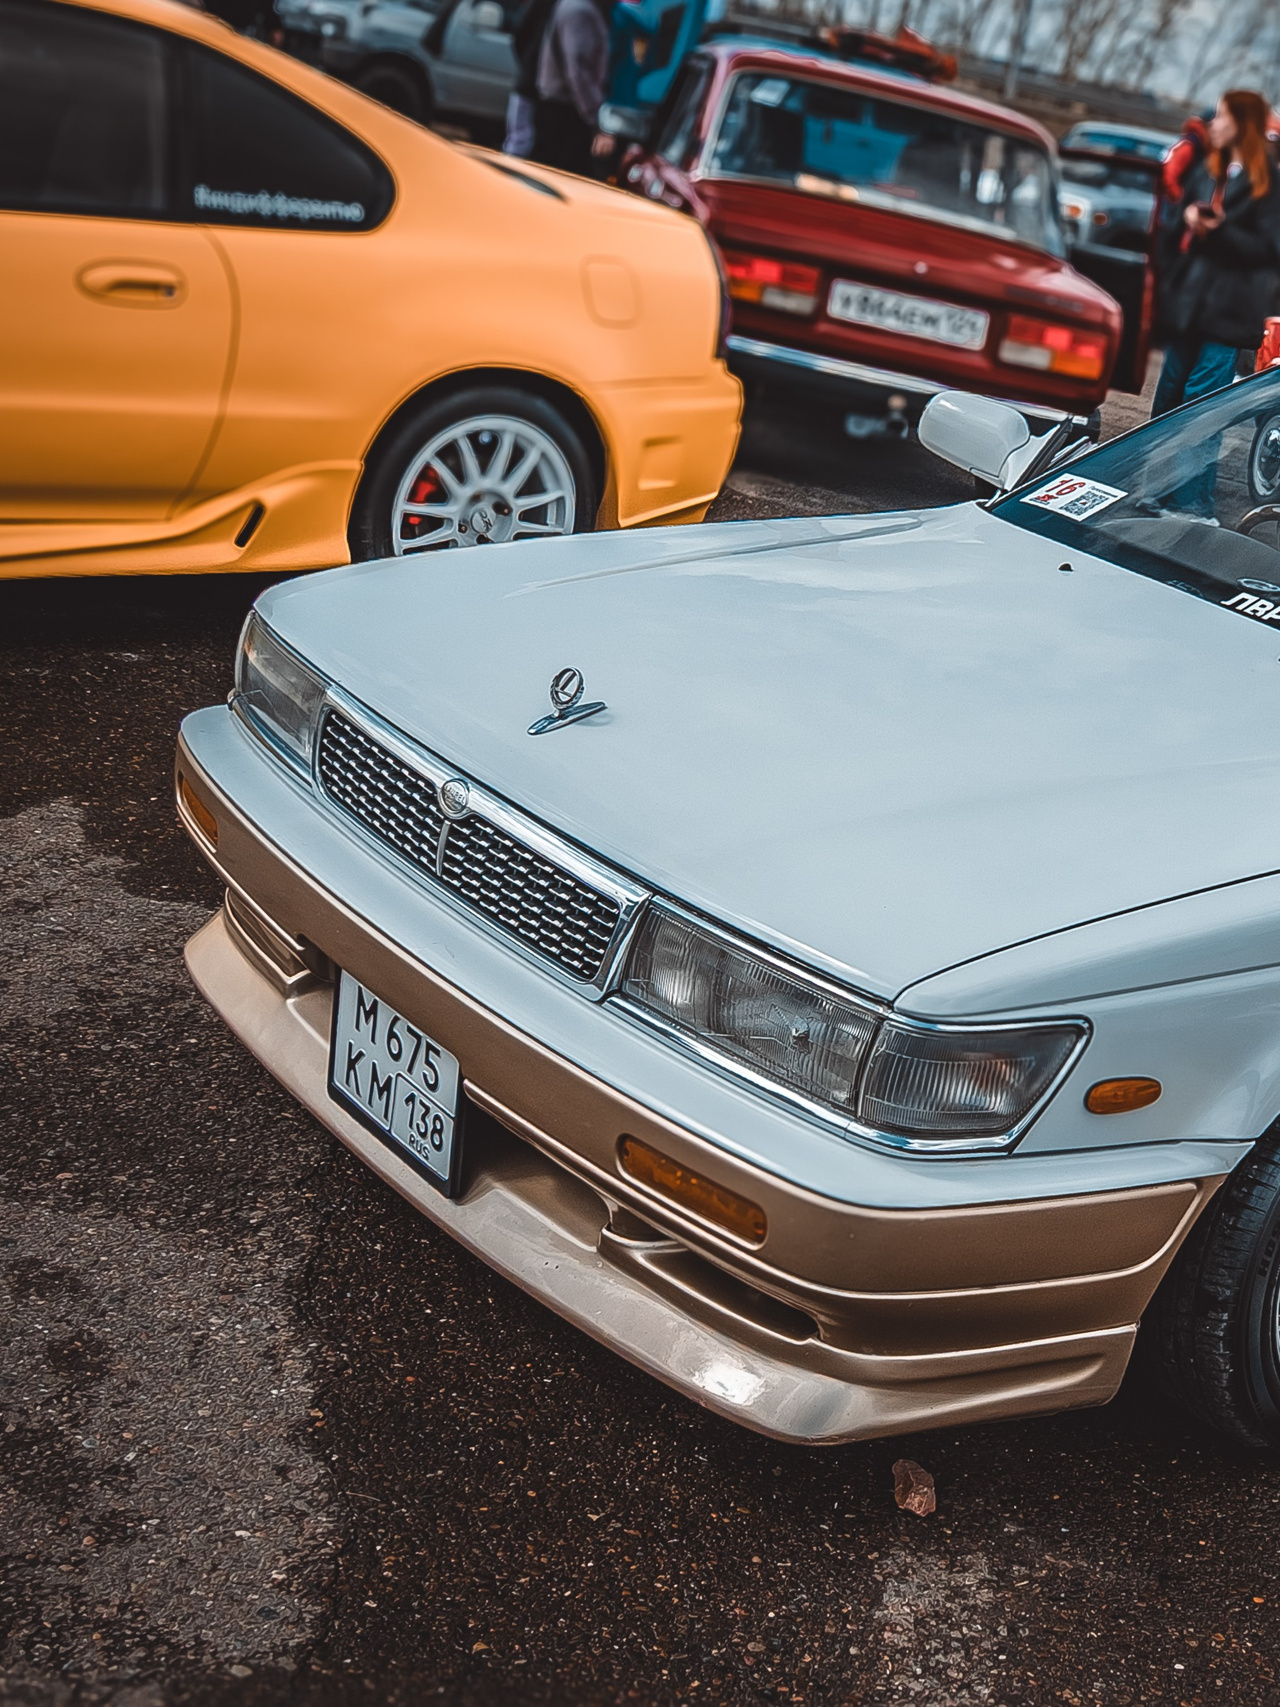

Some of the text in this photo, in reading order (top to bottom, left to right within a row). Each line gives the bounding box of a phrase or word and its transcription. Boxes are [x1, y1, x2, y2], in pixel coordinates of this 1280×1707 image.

[1045, 479, 1086, 496] 16
[445, 784, 466, 806] LAUREL
[355, 984, 441, 1094] M 675
[345, 1039, 444, 1152] KM 138
[408, 1133, 430, 1161] RUS
